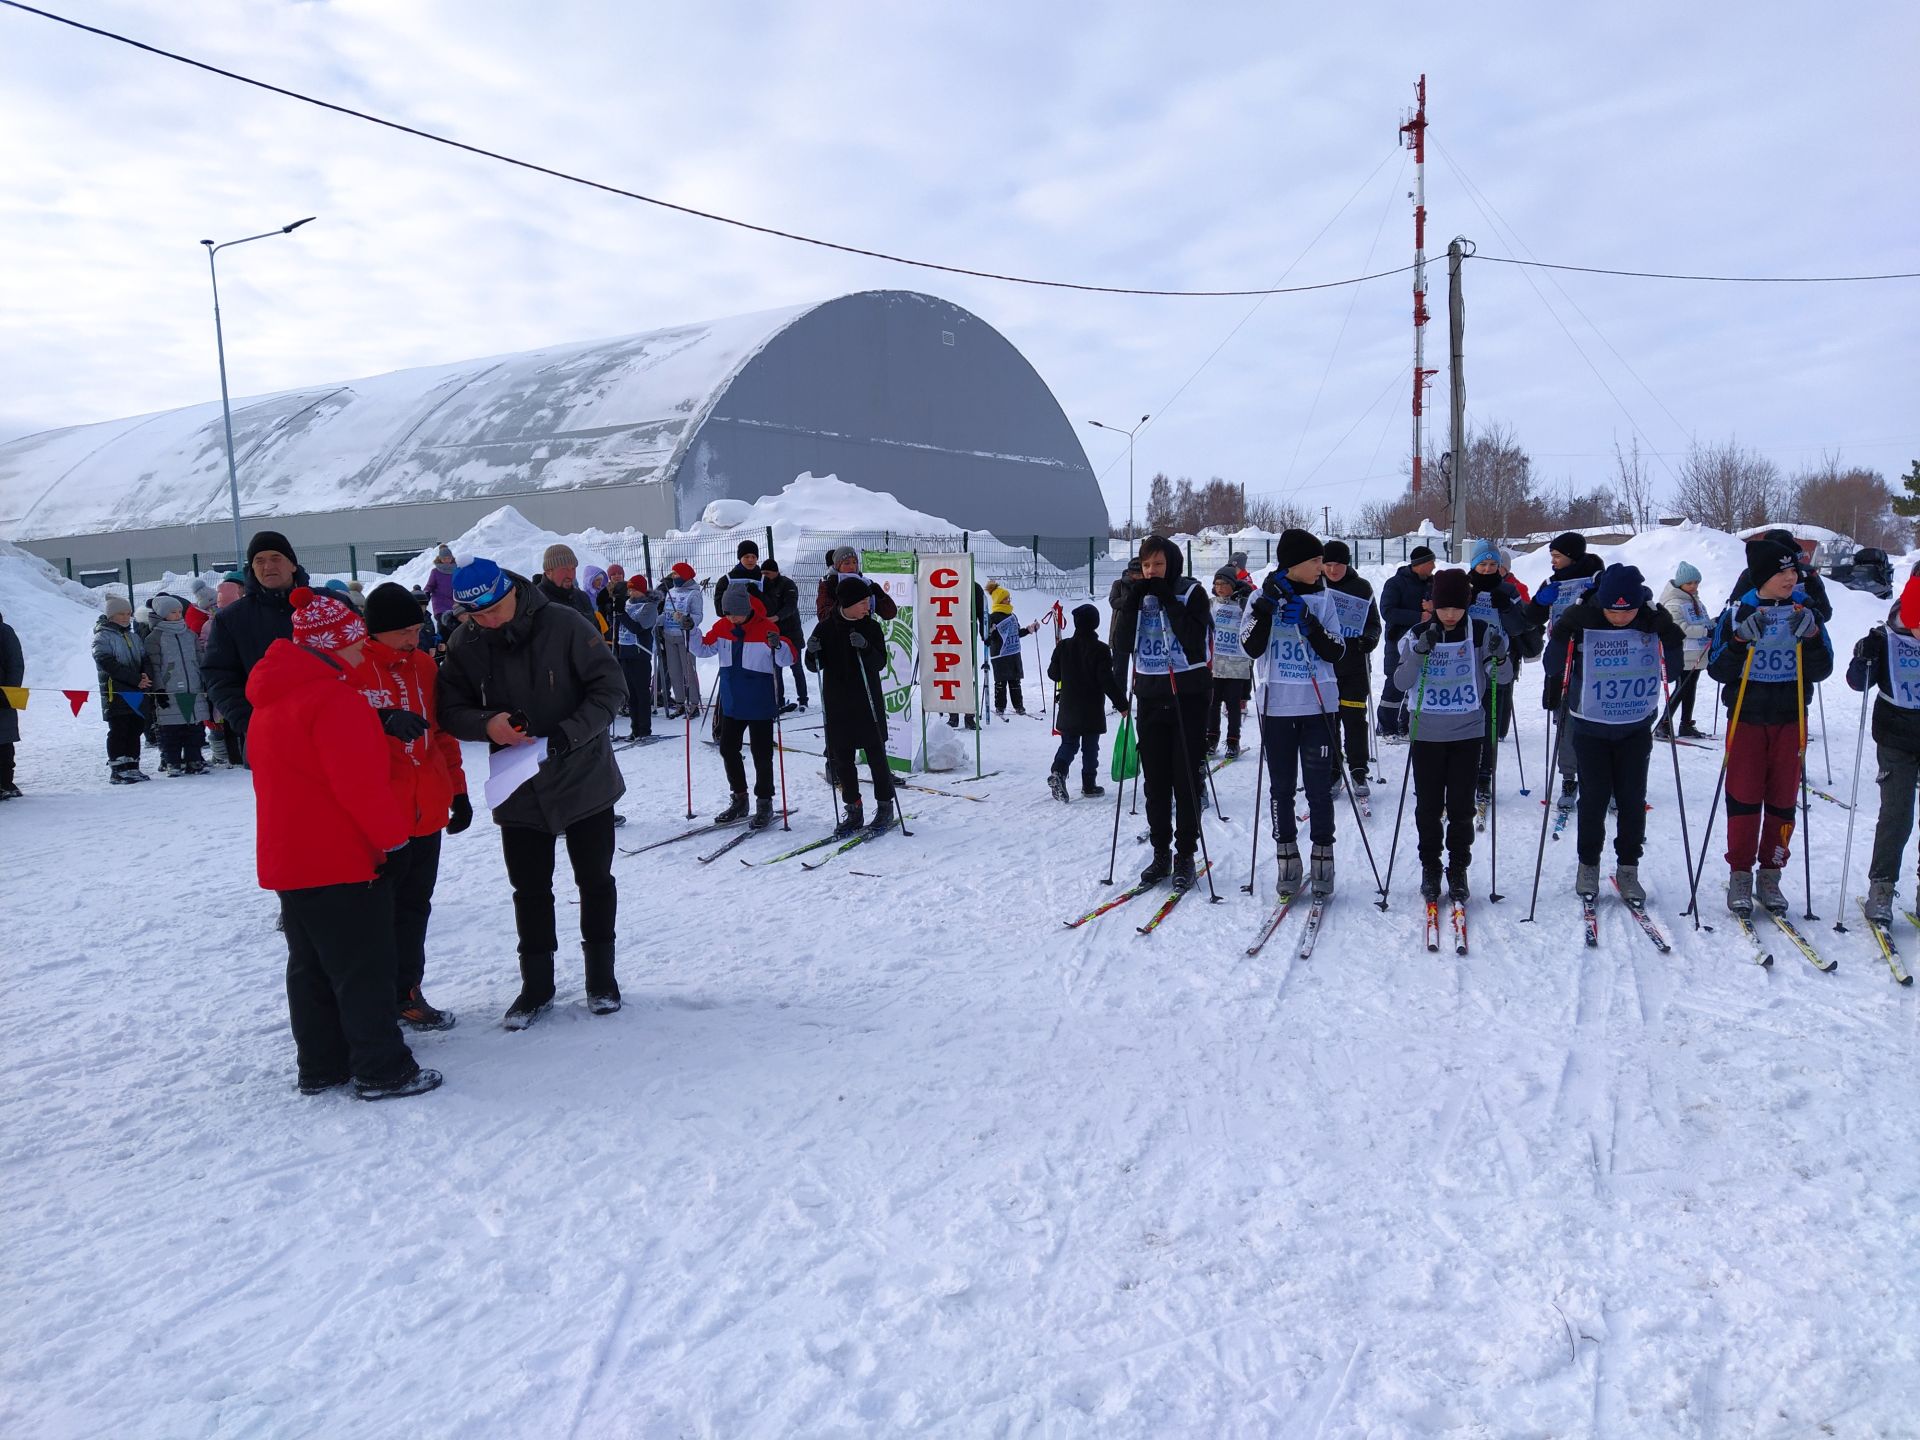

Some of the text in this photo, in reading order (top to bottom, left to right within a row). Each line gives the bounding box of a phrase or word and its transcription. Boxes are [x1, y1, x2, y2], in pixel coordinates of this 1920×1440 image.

[929, 568, 963, 700] СТАРТ
[1593, 640, 1629, 649] ЛЫЖНЯ
[1594, 648, 1630, 657] РОССИИ
[1595, 657, 1629, 667] 2022
[1591, 676, 1658, 700] 13702
[1601, 700, 1650, 709] РЕСПУБЛИКА
[1604, 708, 1647, 717] ТАТАРСТАН
